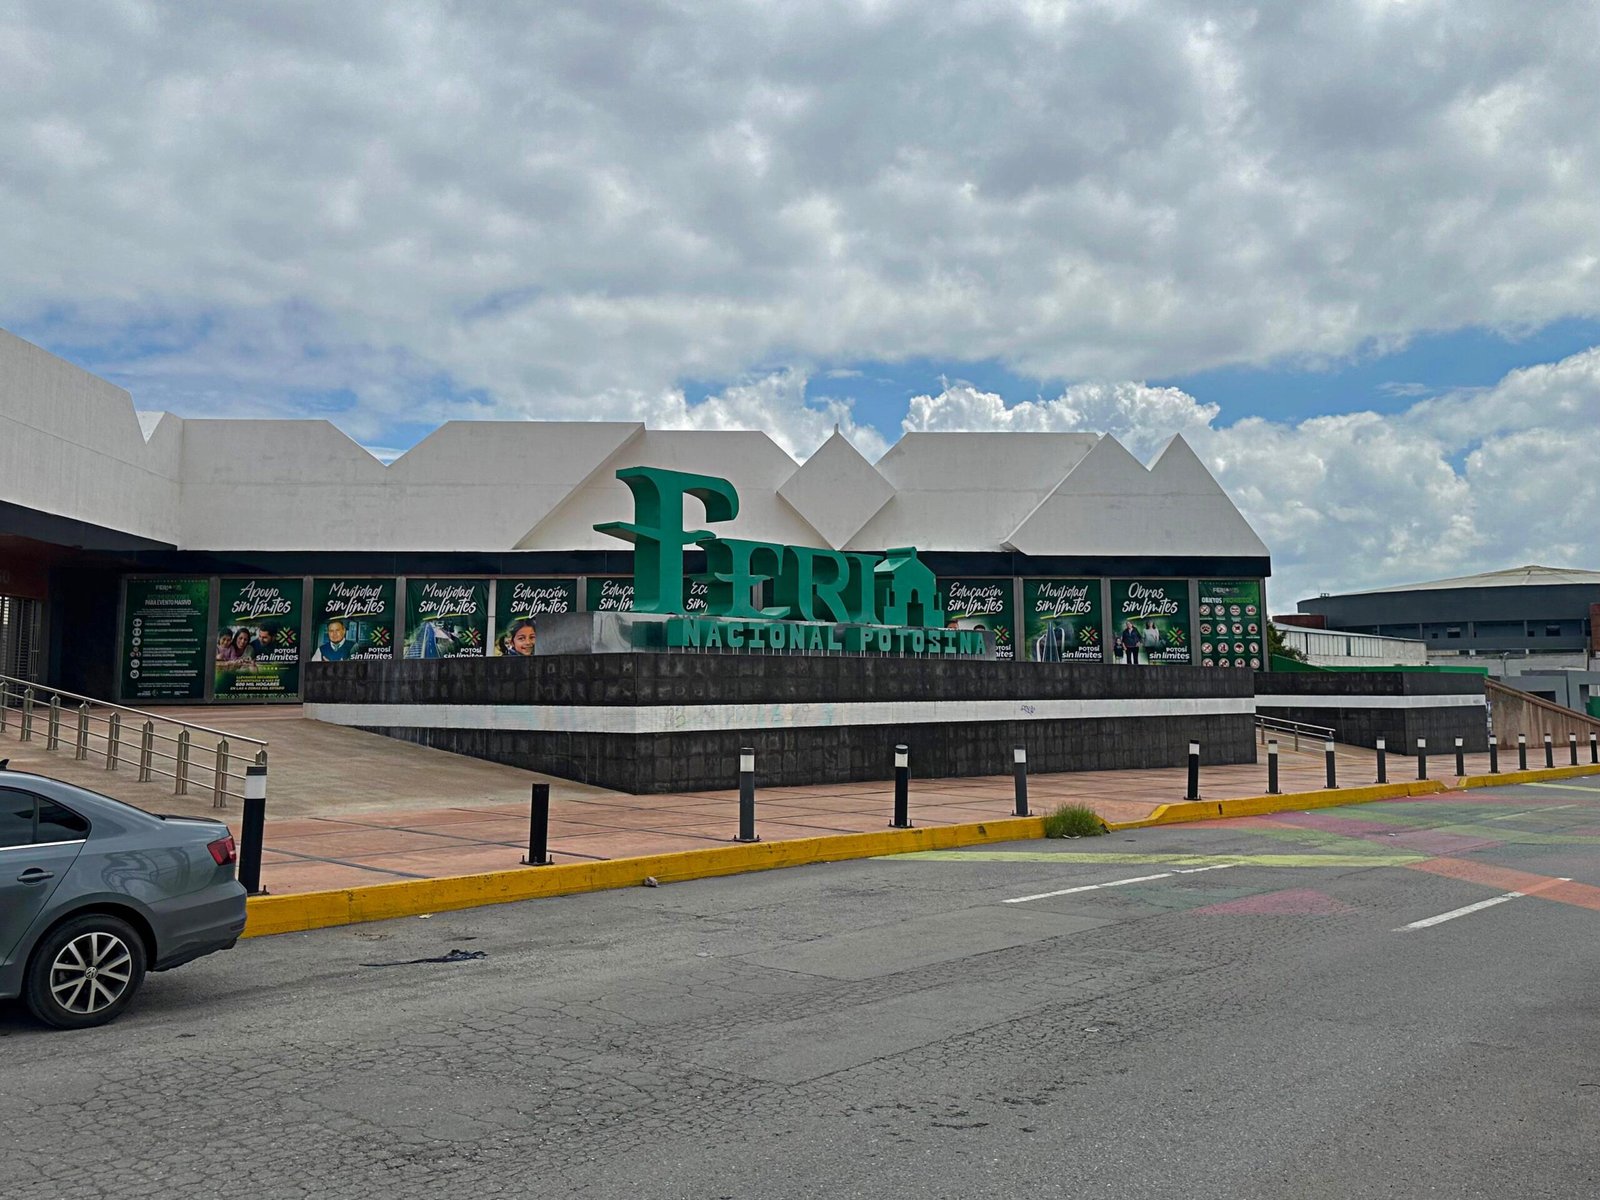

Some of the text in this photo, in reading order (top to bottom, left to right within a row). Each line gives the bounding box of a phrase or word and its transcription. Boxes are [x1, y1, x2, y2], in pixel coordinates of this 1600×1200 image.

[239, 580, 280, 602] Apoyo
[328, 581, 383, 600] Movilidad
[421, 582, 475, 600] Movilidad
[513, 582, 568, 600] Educación
[601, 580, 635, 597] Educa
[949, 581, 1003, 599] Educación
[1037, 582, 1089, 600] Movilidad
[1128, 582, 1164, 599] Obras
[686, 598, 707, 611] sin
[683, 618, 988, 655] NACIONAL POTOSINA
[256, 653, 269, 661] sin
[274, 646, 297, 654] POTOSÍ
[350, 652, 363, 660] sin
[1061, 651, 1074, 659] sin
[1149, 652, 1162, 660] sin
